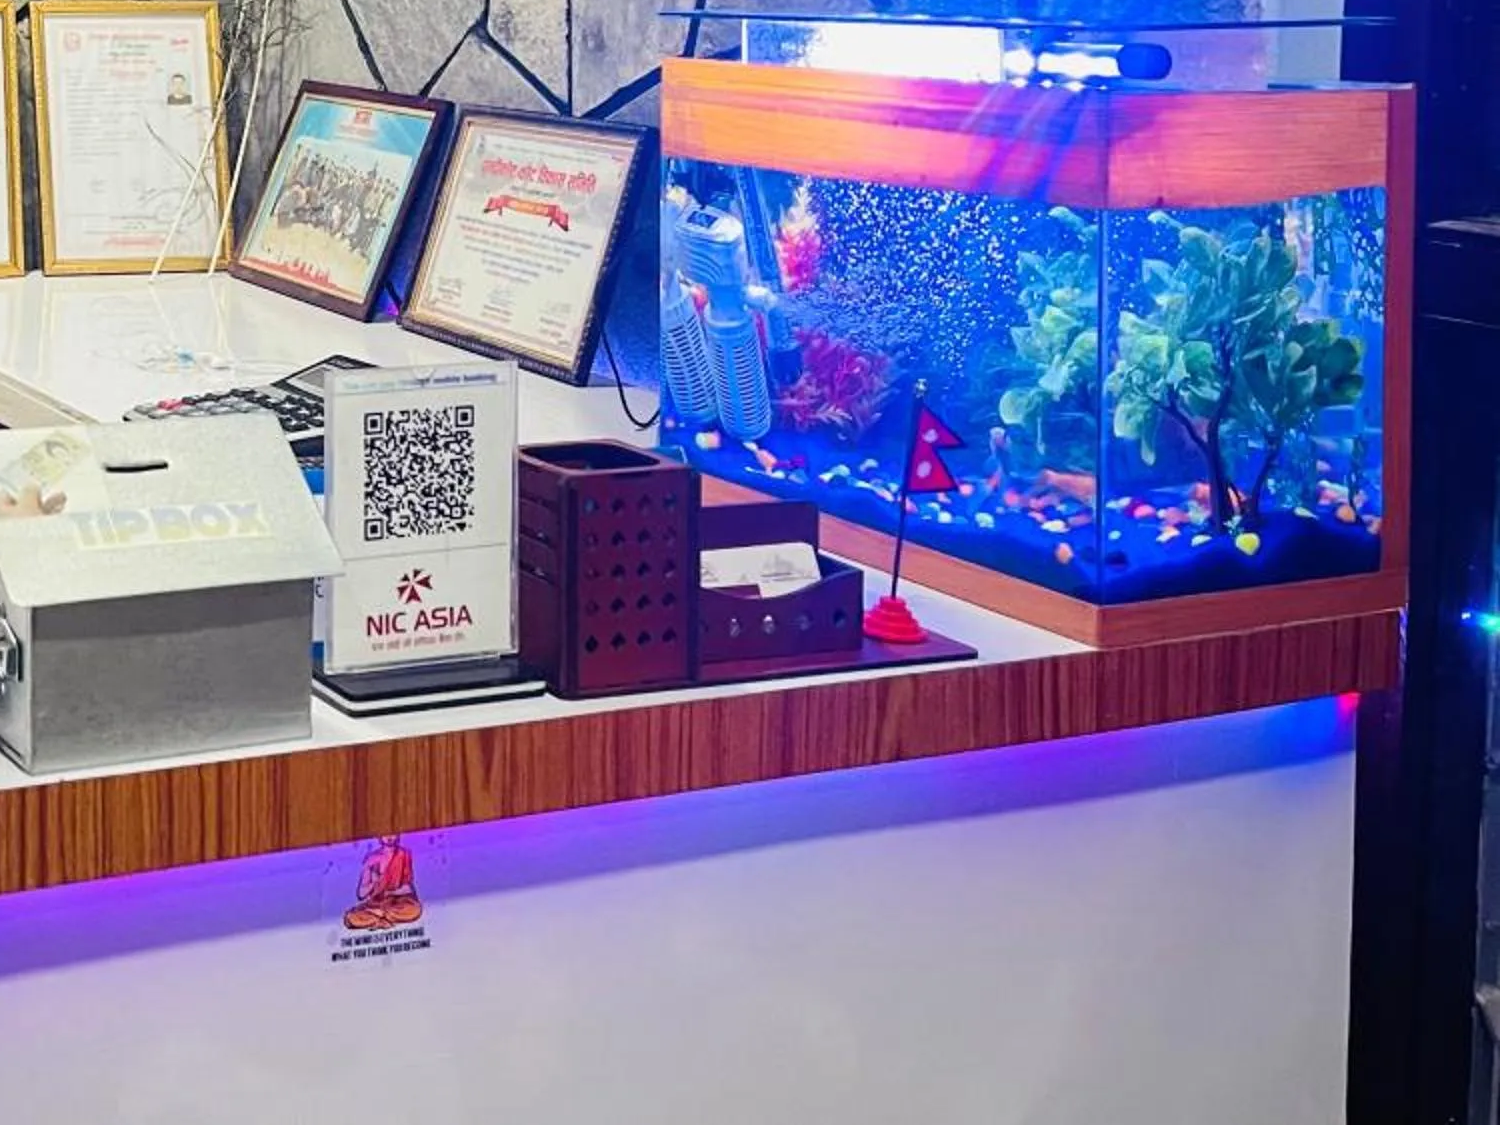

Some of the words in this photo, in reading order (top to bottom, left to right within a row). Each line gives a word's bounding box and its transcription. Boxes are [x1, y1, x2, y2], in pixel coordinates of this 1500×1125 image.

[72, 507, 150, 547] TIP
[151, 502, 268, 540] BOX
[366, 612, 407, 637] NIC
[413, 604, 473, 632] ASIA
